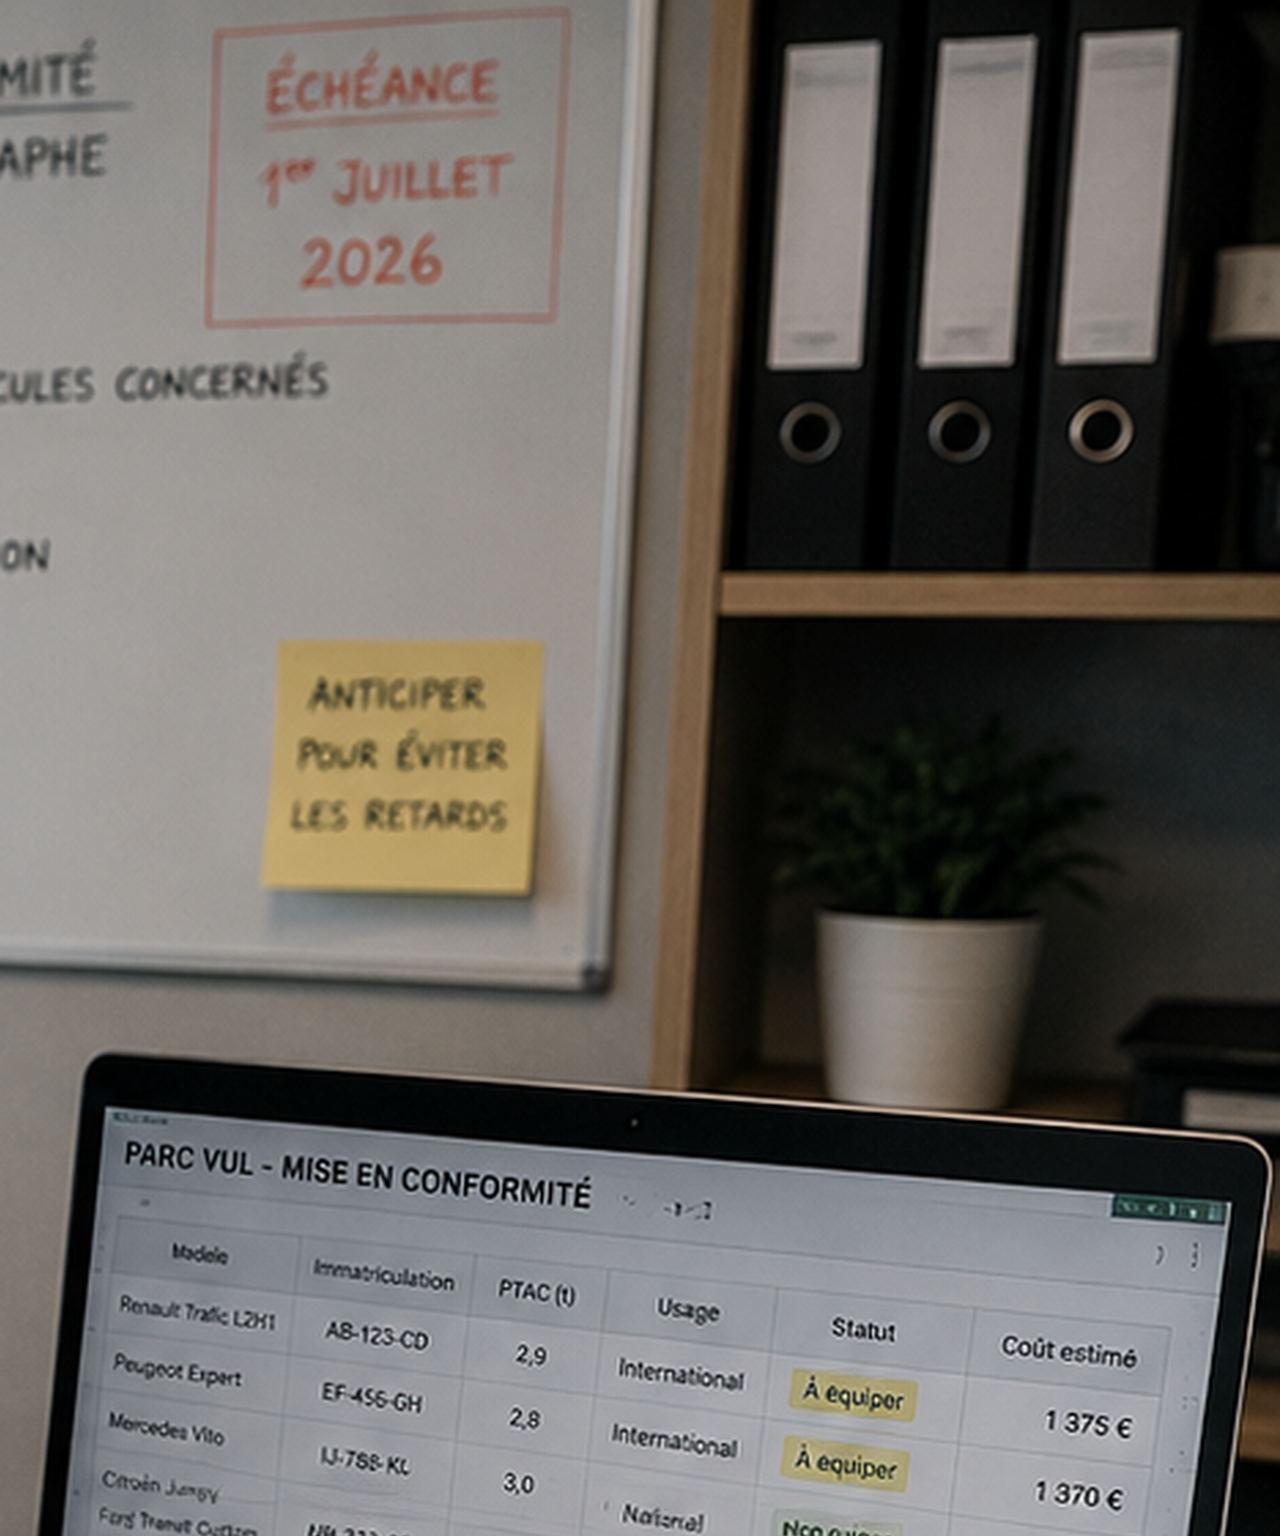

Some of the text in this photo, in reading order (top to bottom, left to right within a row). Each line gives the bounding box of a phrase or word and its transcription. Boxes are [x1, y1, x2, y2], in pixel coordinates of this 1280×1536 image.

[266, 51, 499, 117] ÉCHÉANCE
[333, 153, 513, 206] JUILLET
[300, 233, 443, 289] 2026
[115, 352, 328, 402] CONCERNÉS
[308, 677, 485, 711] ANTICIPER
[298, 729, 507, 771] POUR ÉVITER
[290, 799, 507, 832] LES RETARDS
[125, 1141, 194, 1169] PARC
[203, 1148, 253, 1175] VUL
[282, 1155, 348, 1184] MISE
[357, 1163, 393, 1189] EN
[402, 1167, 591, 1209] CONFORMITÉ
[499, 1279, 575, 1307] PTAC (t)
[658, 1298, 720, 1326] Usage
[833, 1317, 895, 1342] Statut
[516, 1344, 546, 1366] 2,9
[1003, 1336, 1137, 1368] Coût estimé
[619, 1357, 744, 1391] International
[510, 1408, 540, 1430] 2,8
[1065, 1412, 1109, 1436] 375
[612, 1423, 737, 1458] International
[504, 1472, 534, 1495] 3,0
[1055, 1483, 1100, 1507] 370
